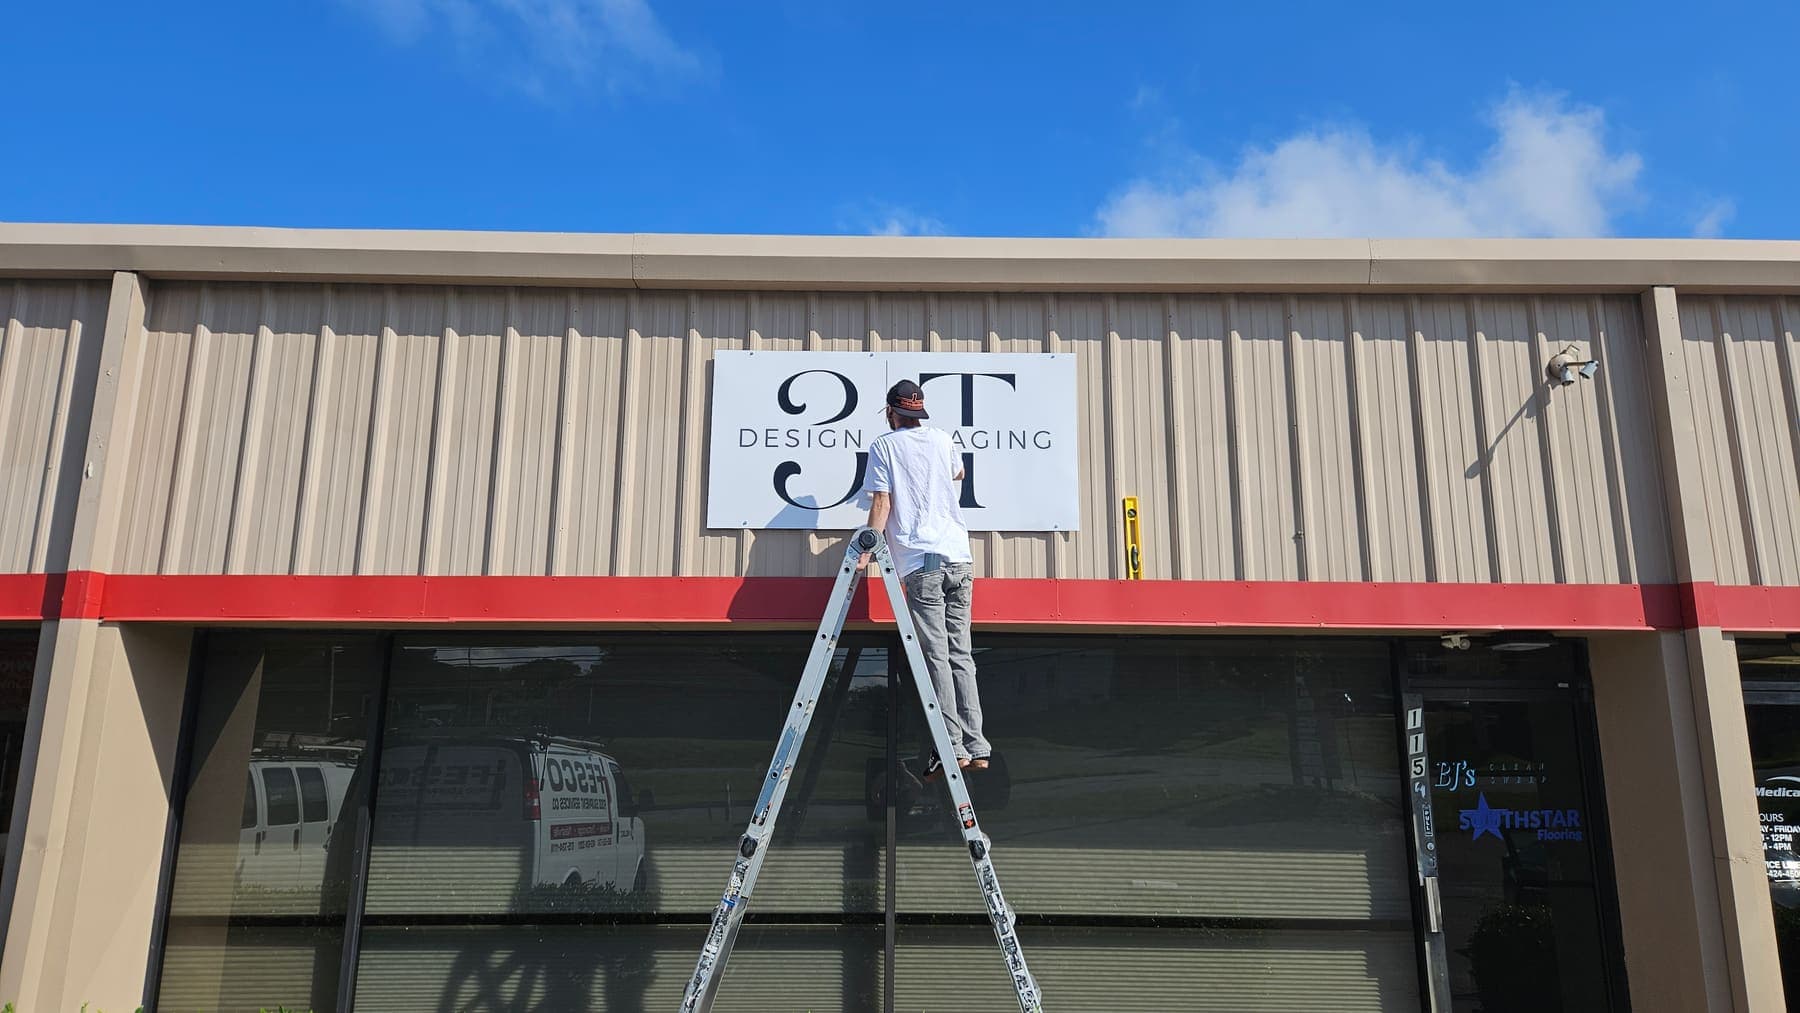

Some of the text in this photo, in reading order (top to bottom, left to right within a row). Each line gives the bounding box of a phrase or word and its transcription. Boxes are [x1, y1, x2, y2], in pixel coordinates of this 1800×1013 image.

[738, 428, 1053, 450] DESIGN AGING
[1434, 760, 1476, 792] BJ's
[1759, 813, 1785, 823] OURS
[1760, 825, 1769, 833] AY
[1537, 828, 1583, 842] Flooring
[1770, 833, 1793, 842] 12PM
[1773, 842, 1792, 851] 4PM
[1765, 860, 1781, 869] ICE
